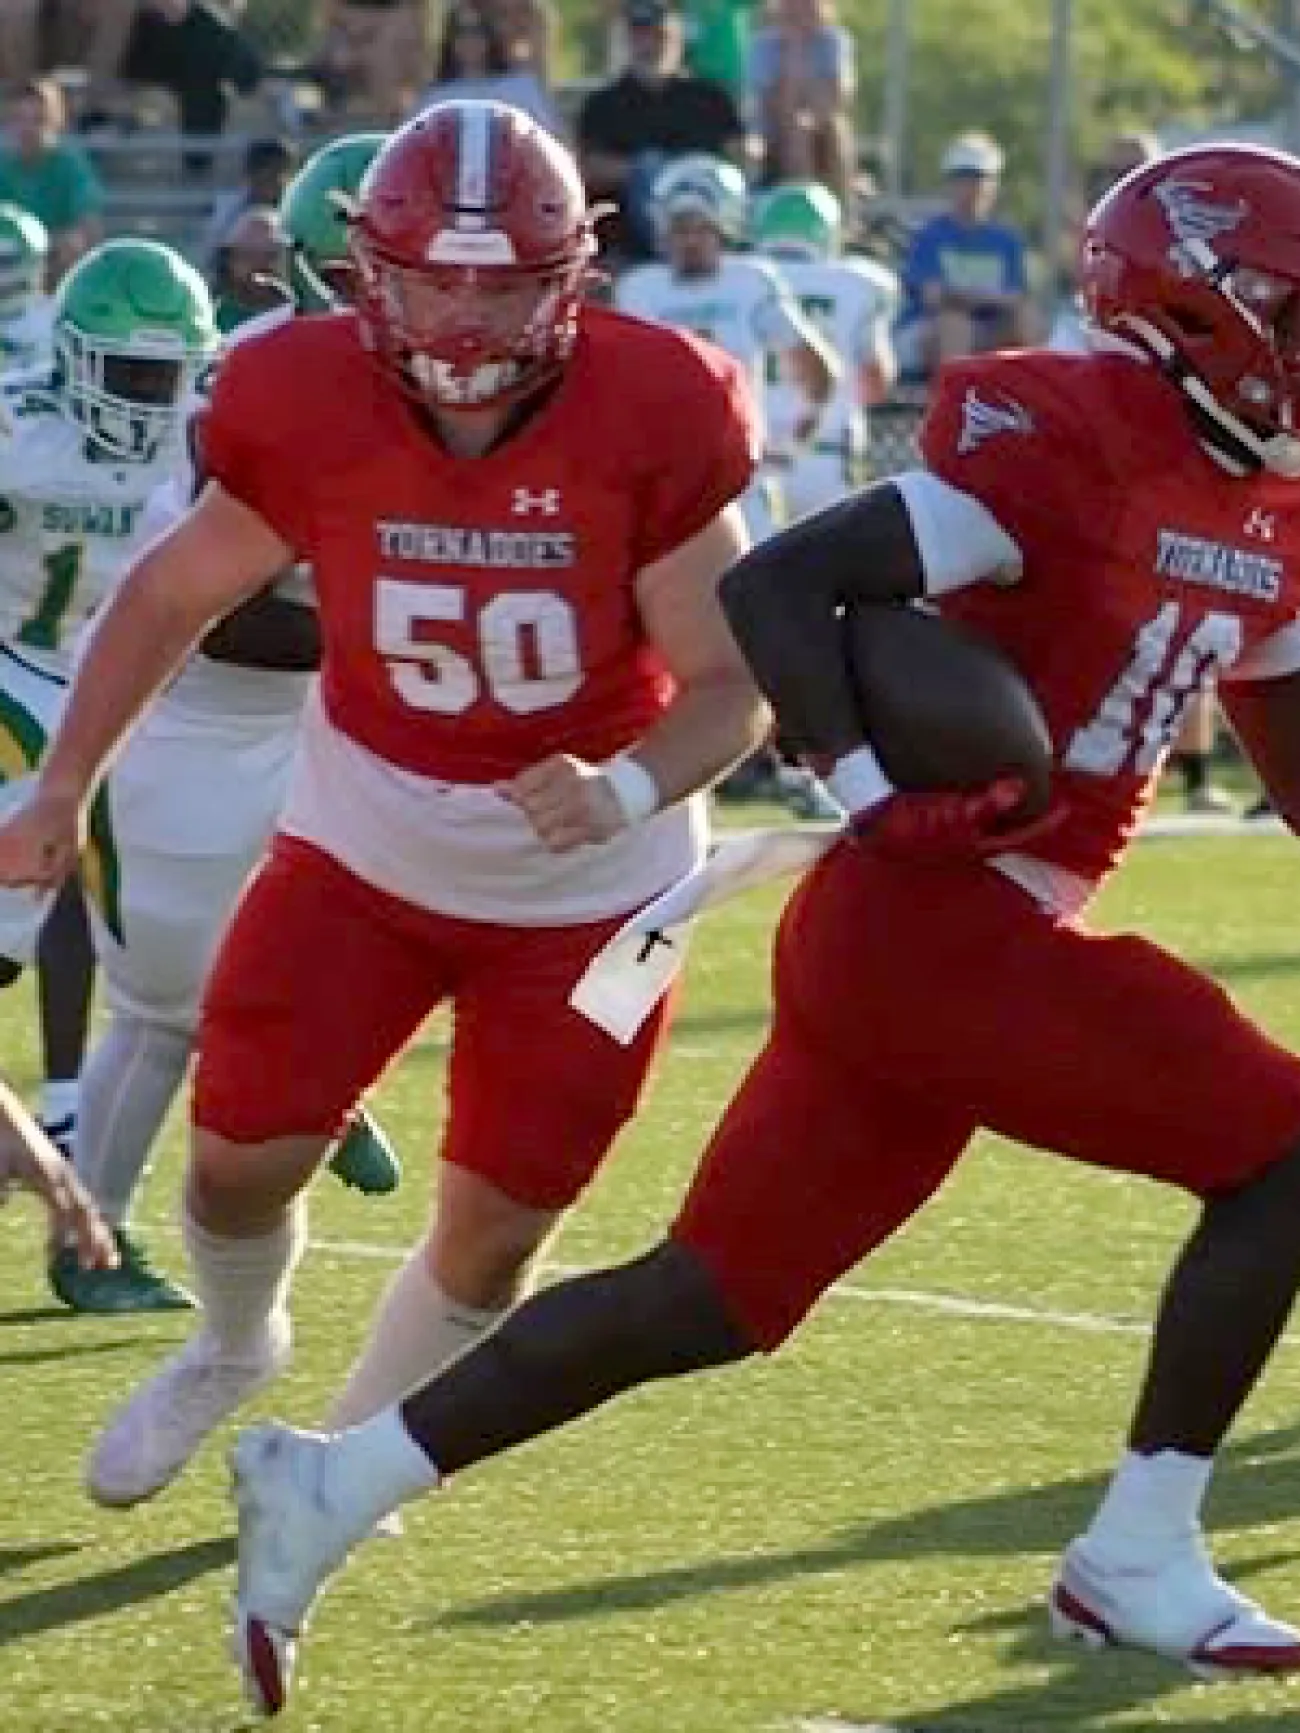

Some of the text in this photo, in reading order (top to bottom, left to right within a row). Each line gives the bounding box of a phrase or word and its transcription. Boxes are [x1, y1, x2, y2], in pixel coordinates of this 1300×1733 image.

[375, 522, 574, 568] TORNADOES
[1155, 528, 1283, 603] TORNADOES
[19, 541, 83, 650] 1
[373, 577, 587, 716] 50
